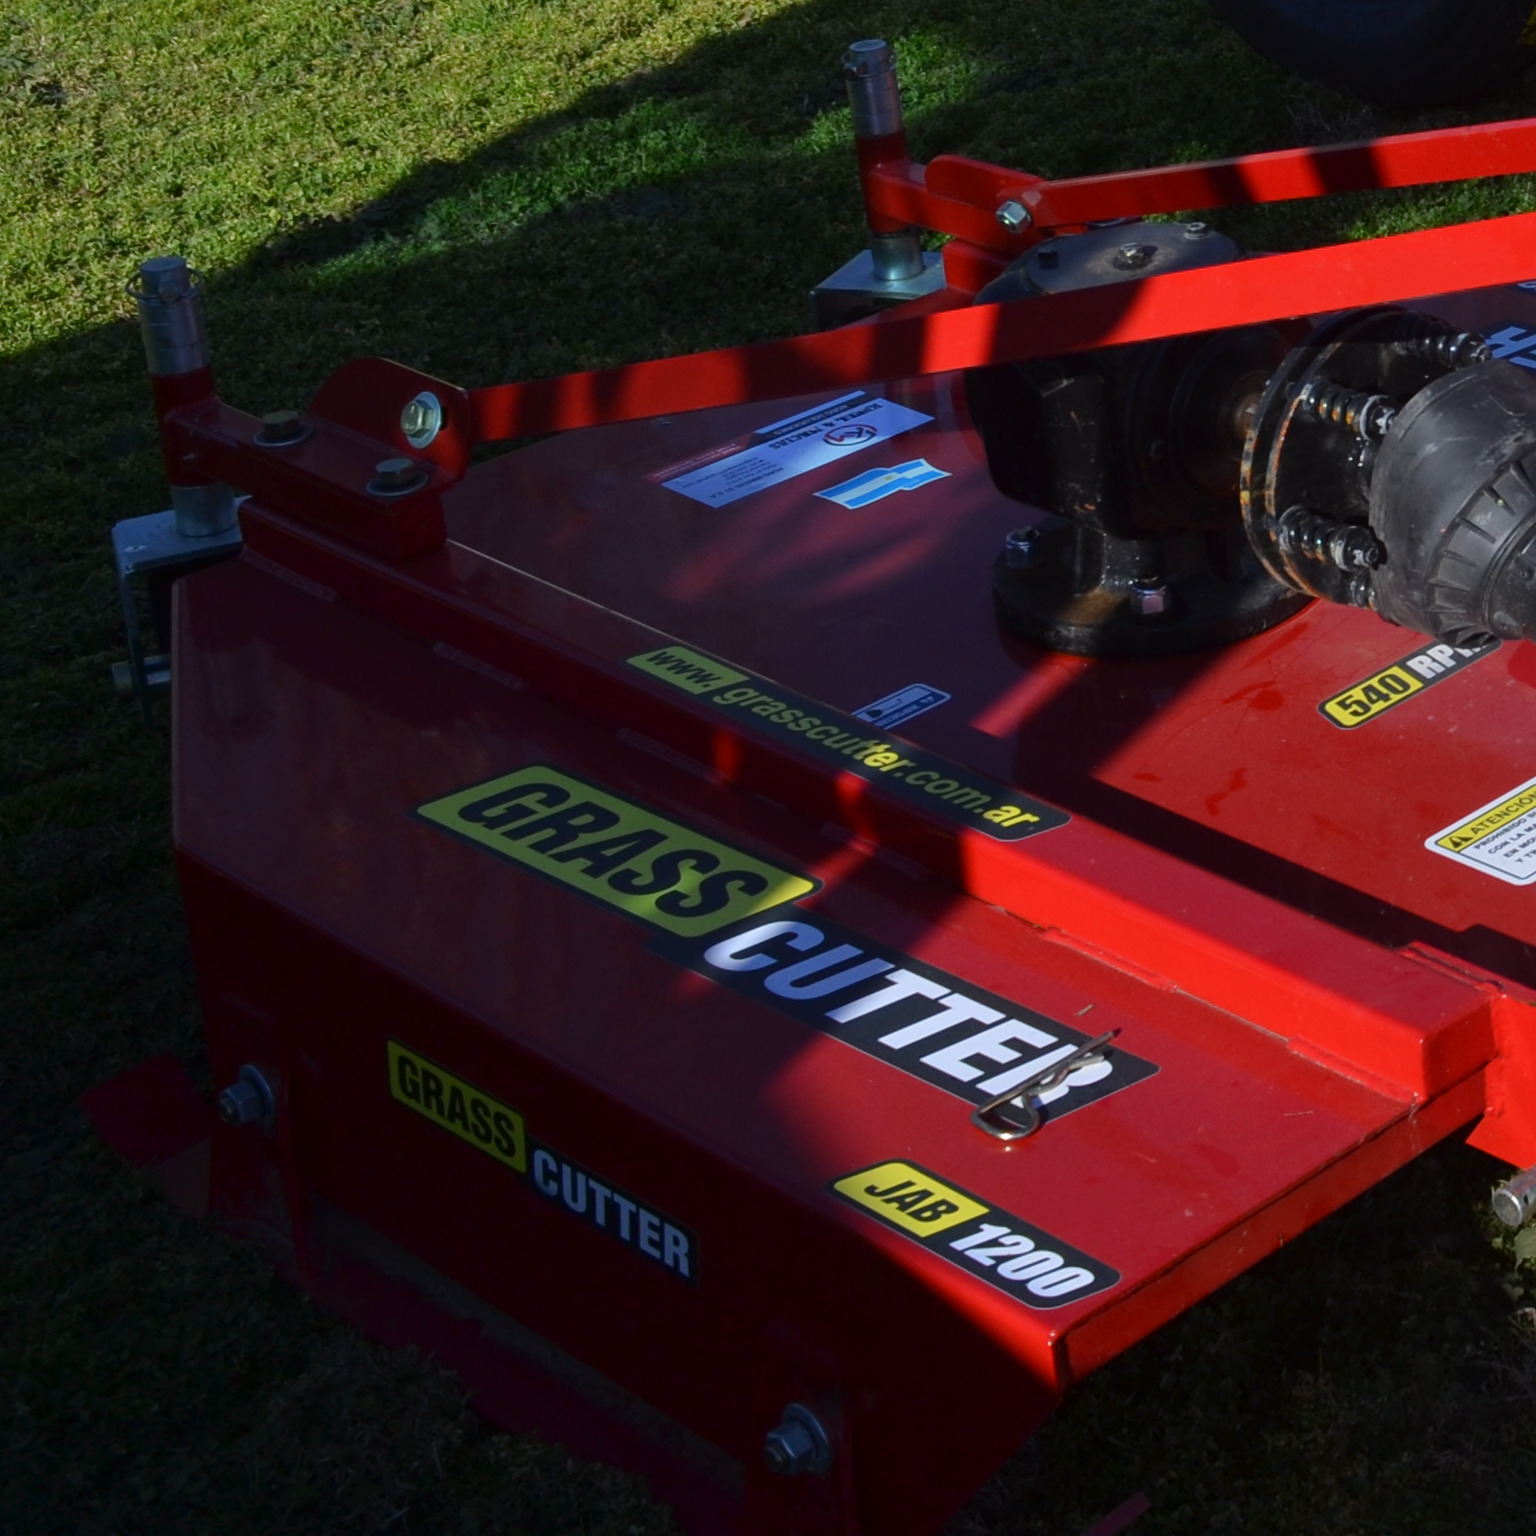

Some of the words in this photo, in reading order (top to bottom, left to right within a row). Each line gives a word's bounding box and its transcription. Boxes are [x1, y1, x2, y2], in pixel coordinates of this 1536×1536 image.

[1335, 672, 1412, 718] 540
[1405, 643, 1491, 680] RP
[647, 650, 723, 689] www.
[713, 686, 1041, 828] grasscutter.com.ar
[1473, 818, 1527, 850] PROHIBIDO
[1487, 840, 1510, 855] CON
[1510, 831, 1525, 842] LA
[1503, 848, 1519, 858] EN
[456, 782, 769, 922] GRASS
[703, 920, 1113, 1108] CUTTER
[397, 1055, 517, 1158] GRASS
[533, 1148, 690, 1278] CUTTER
[863, 1179, 961, 1223] JAB
[949, 1223, 1096, 1298] 1200
